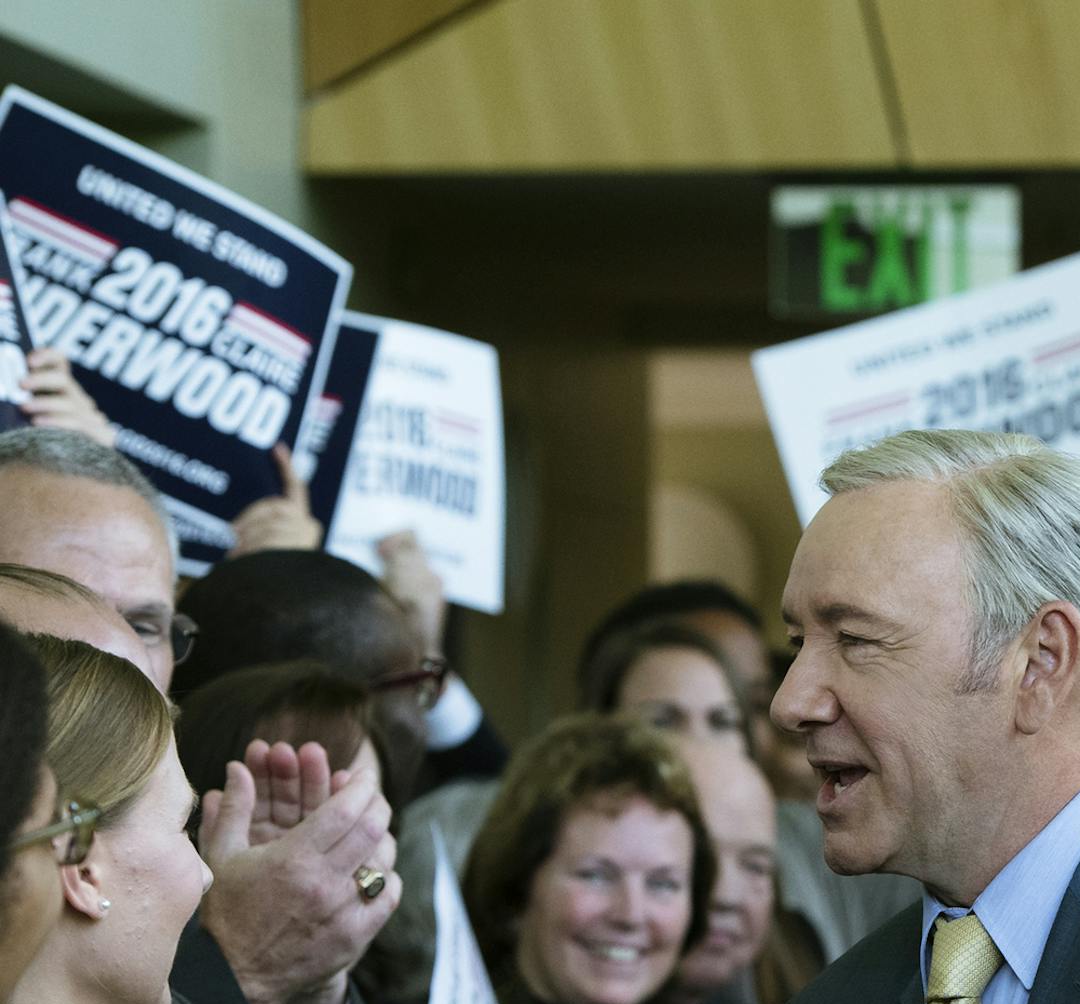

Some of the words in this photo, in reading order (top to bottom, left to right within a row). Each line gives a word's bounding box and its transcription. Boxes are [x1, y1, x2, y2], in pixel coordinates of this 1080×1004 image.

[76, 164, 177, 231] UNITED
[172, 209, 218, 253] WE
[211, 230, 288, 288] STAND
[90, 246, 234, 348] 2016
[211, 328, 305, 397] CLAIRE
[921, 354, 1026, 429] 2016
